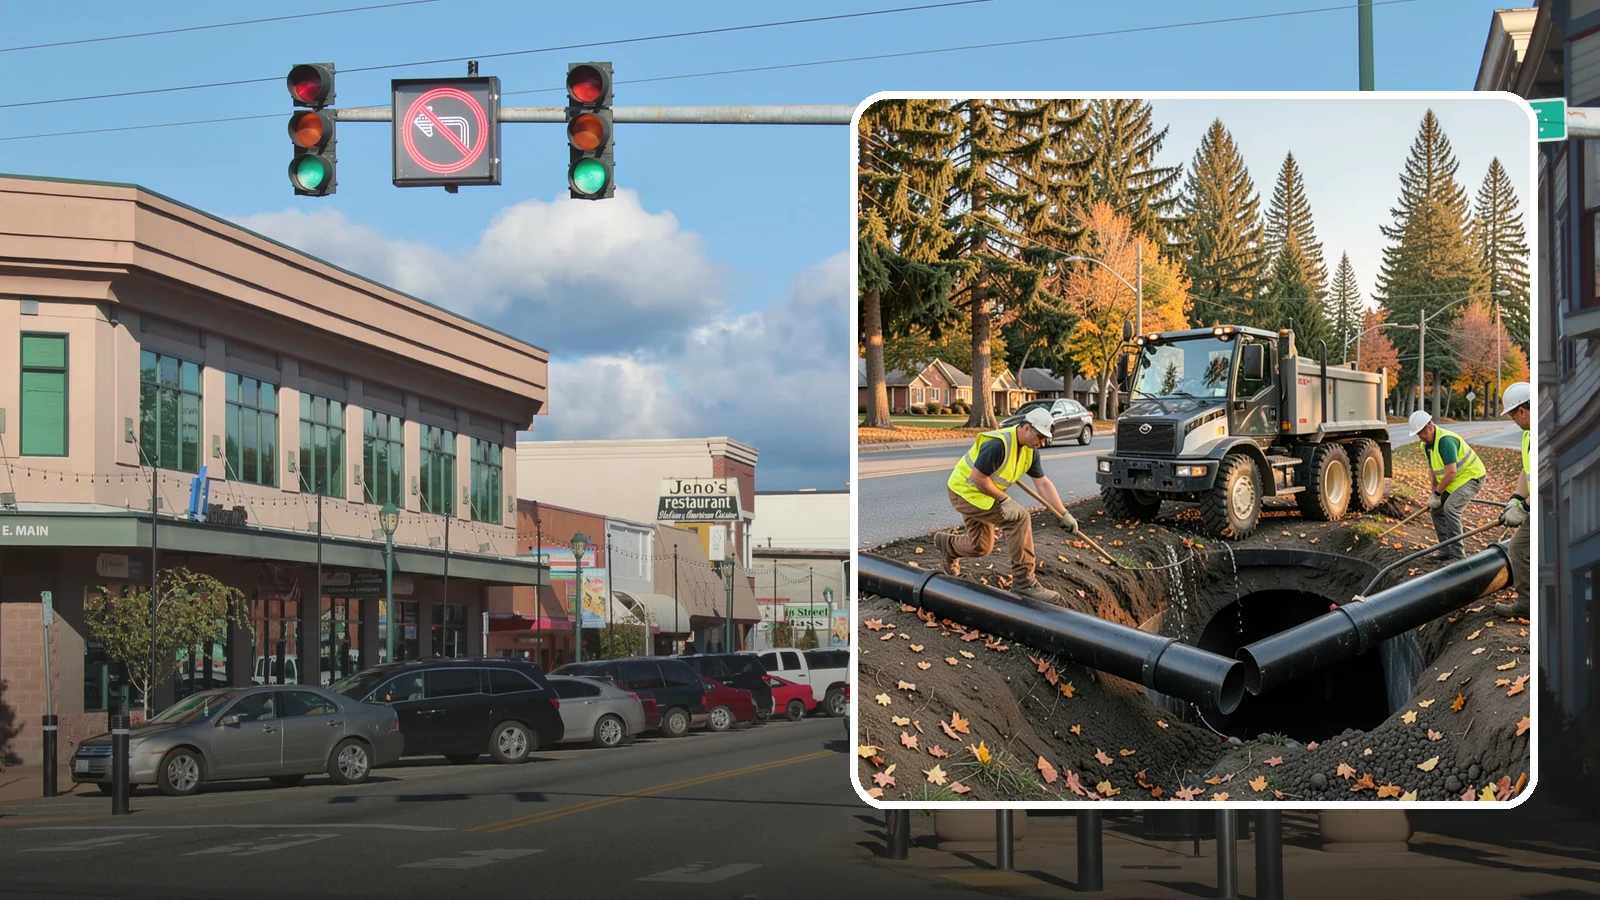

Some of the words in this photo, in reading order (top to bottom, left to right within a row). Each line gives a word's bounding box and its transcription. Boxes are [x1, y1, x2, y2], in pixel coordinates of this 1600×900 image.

[670, 480, 727, 494] Jeno's
[665, 496, 731, 509] restaurant
[658, 509, 681, 519] Italian
[686, 509, 715, 518] American
[715, 509, 737, 519] Cuisine
[2, 525, 13, 536] E.
[15, 525, 49, 536] MAIN
[797, 607, 828, 617] Street
